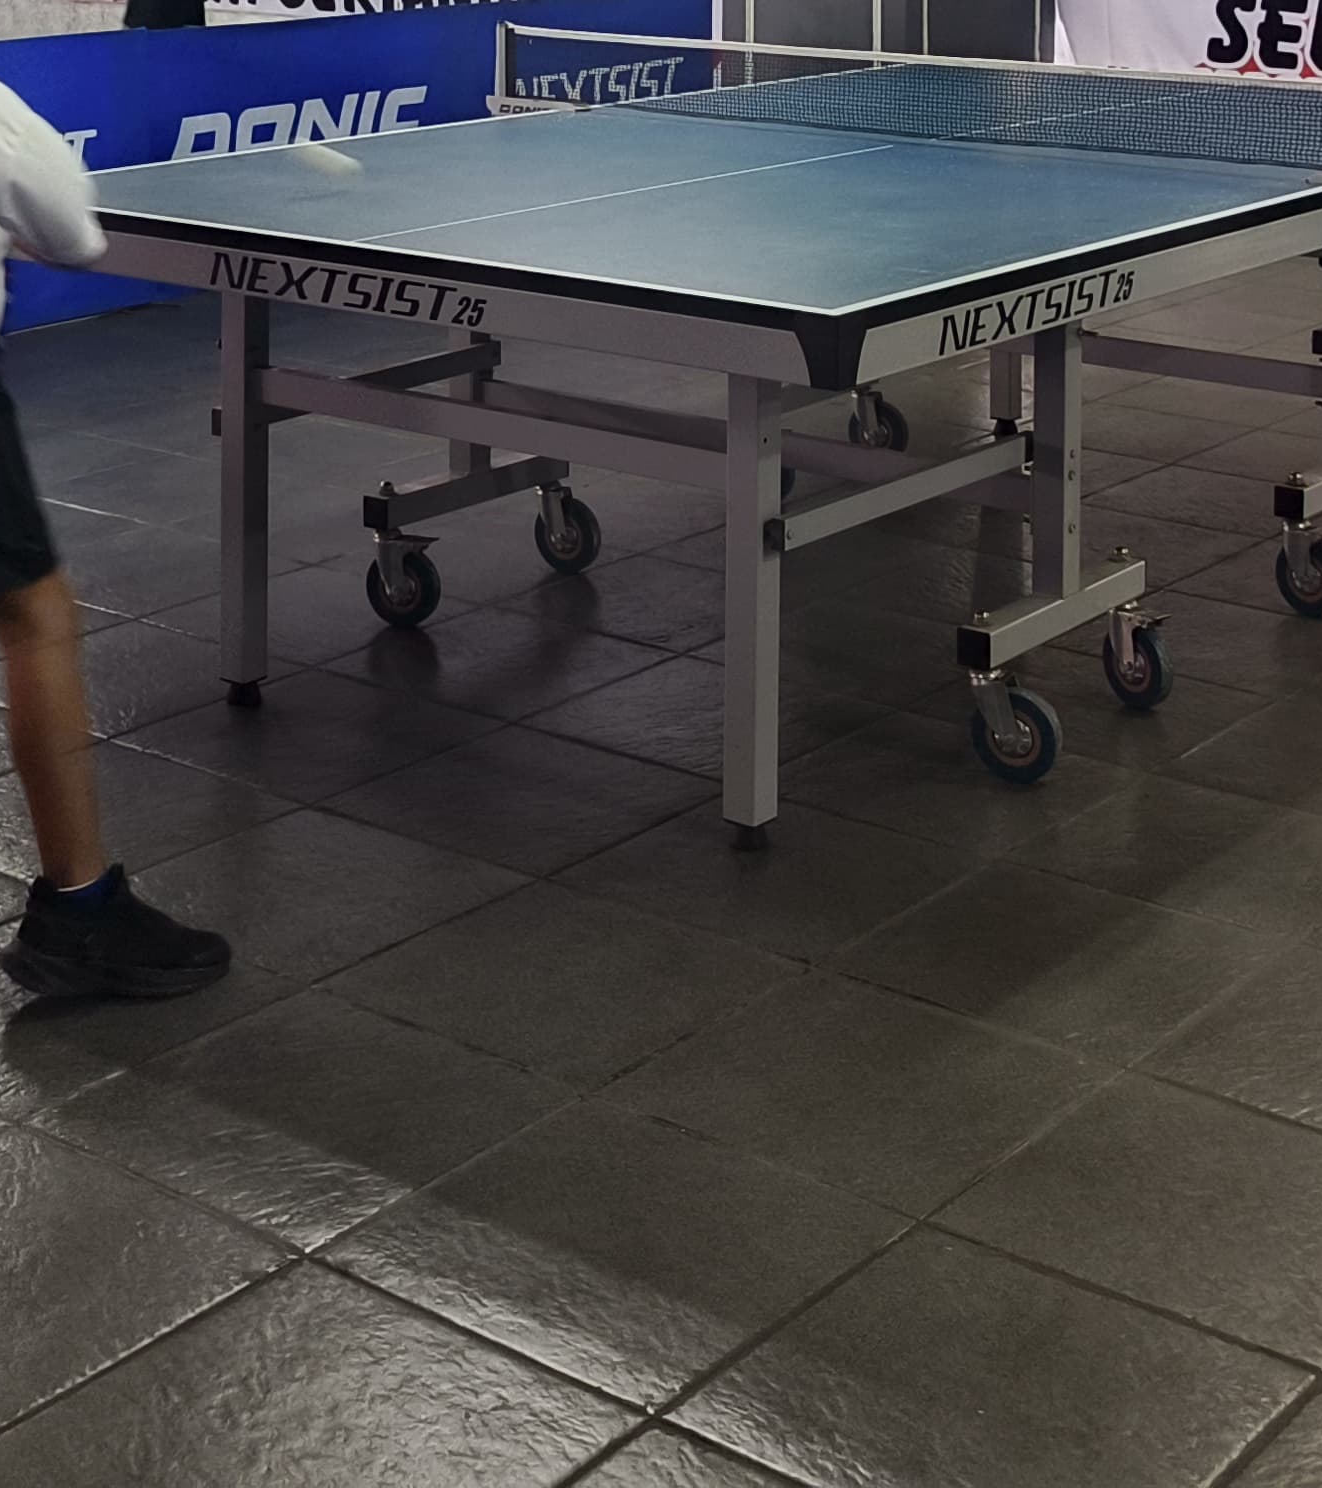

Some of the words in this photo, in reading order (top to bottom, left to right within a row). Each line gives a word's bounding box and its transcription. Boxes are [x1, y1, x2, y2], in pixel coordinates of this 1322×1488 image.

[209, 251, 458, 321] NEXTSIST
[451, 295, 488, 328] 25
[939, 269, 1118, 356] NEXTSIST
[1113, 270, 1135, 304] 25
